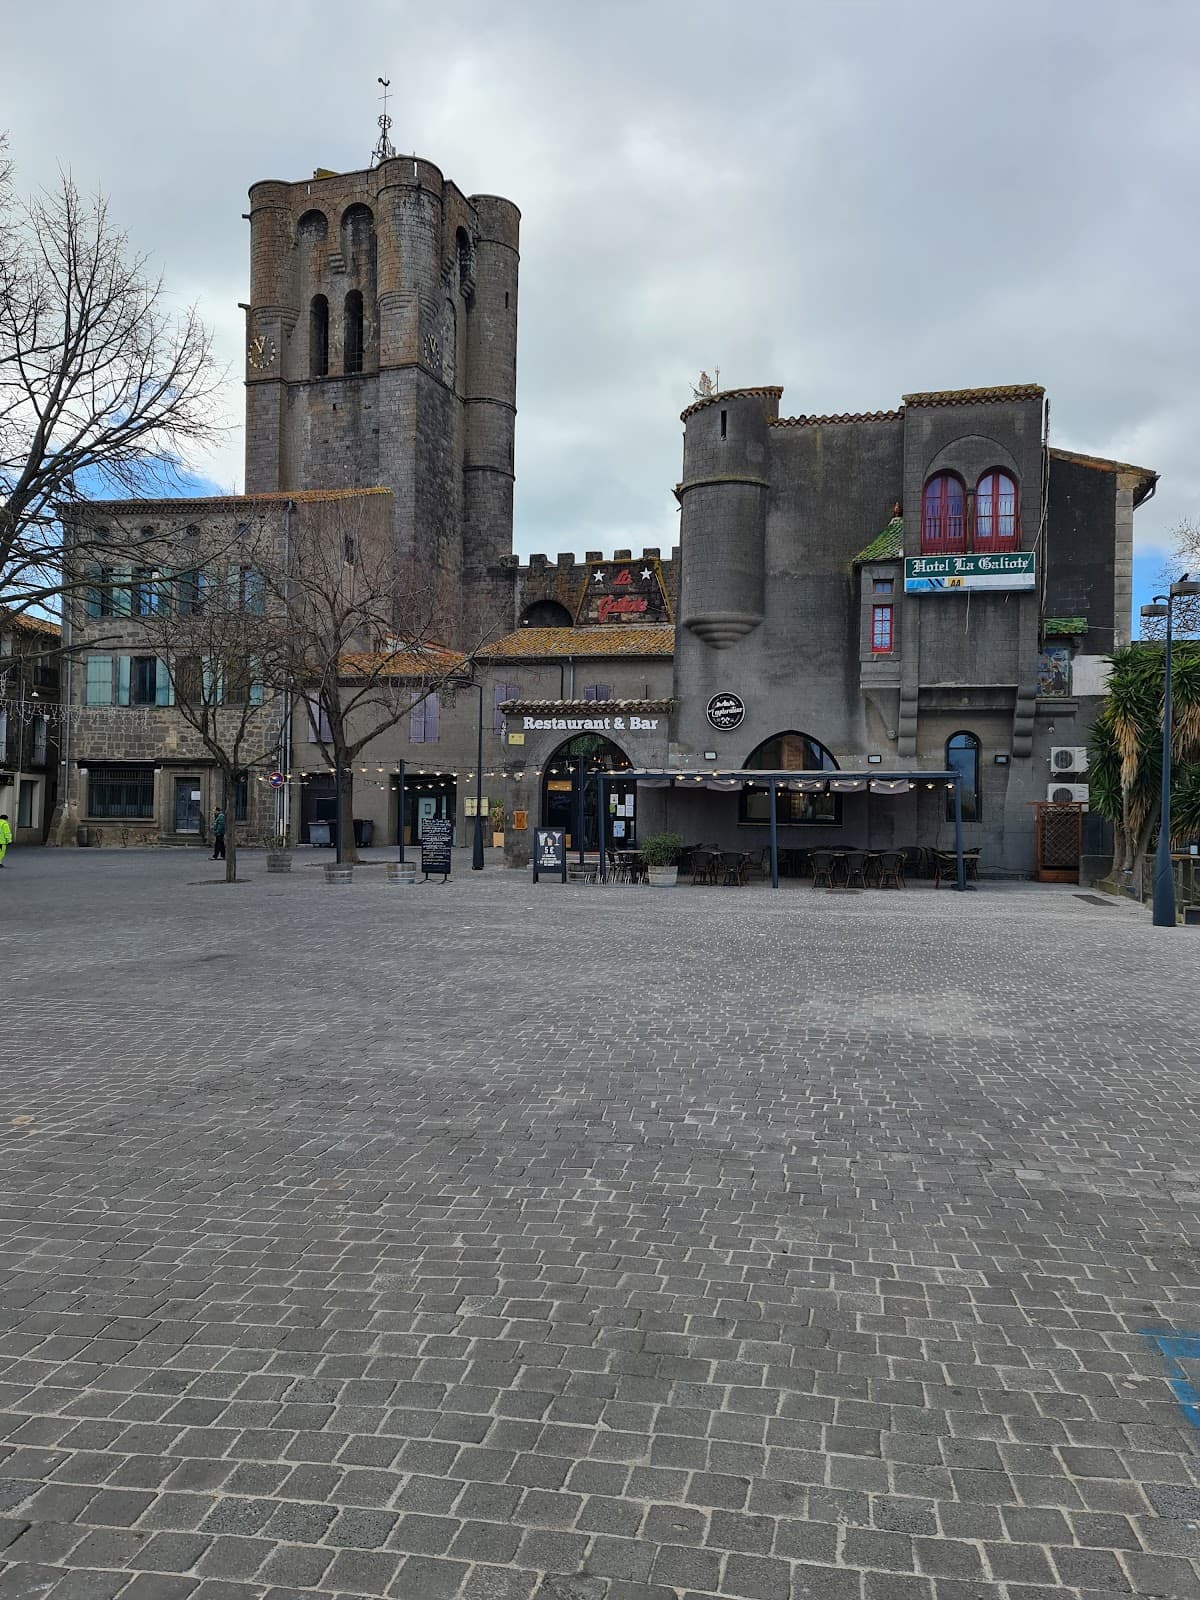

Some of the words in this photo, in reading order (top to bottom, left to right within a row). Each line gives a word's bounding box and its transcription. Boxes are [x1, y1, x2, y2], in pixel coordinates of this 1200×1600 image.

[911, 559, 949, 576] Hotel
[953, 557, 974, 575] La
[978, 557, 1028, 570] Galiote
[523, 716, 610, 730] Restaurant
[613, 717, 625, 730] &
[629, 716, 658, 730] Bar
